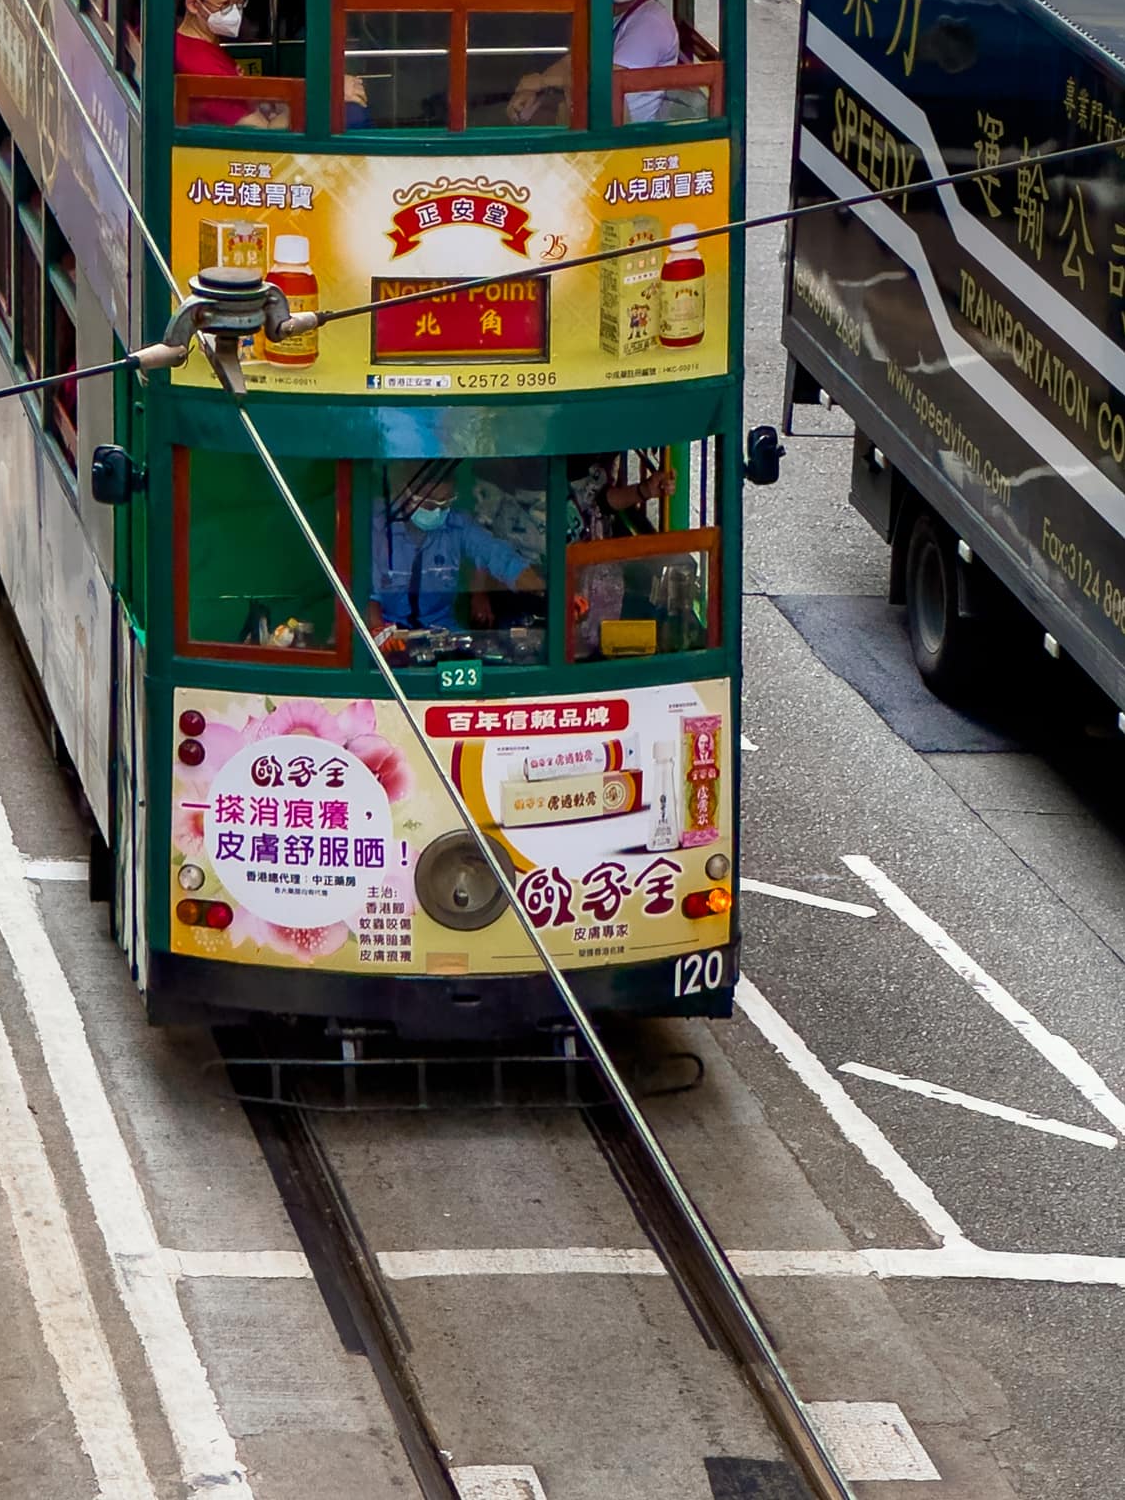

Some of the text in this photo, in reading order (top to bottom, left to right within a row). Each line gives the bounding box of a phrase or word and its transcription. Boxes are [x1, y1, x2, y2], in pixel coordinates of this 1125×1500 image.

[642, 156, 680, 172] 正安堂
[832, 87, 915, 214] SPEEDY
[229, 162, 272, 179] 正安堂
[188, 178, 314, 210] 小兒健胃寶
[604, 171, 715, 204] 小兒感冒素
[415, 199, 509, 228] 正安堂
[415, 308, 503, 337] 北角
[959, 268, 1090, 431] TRANSPORTATION
[468, 373, 509, 388] 2572
[516, 372, 557, 387] 9396
[886, 359, 1011, 508] www.speedytran.com
[441, 668, 477, 687] S23
[446, 705, 611, 732] 百年信賴品牌
[674, 950, 724, 998] 120
